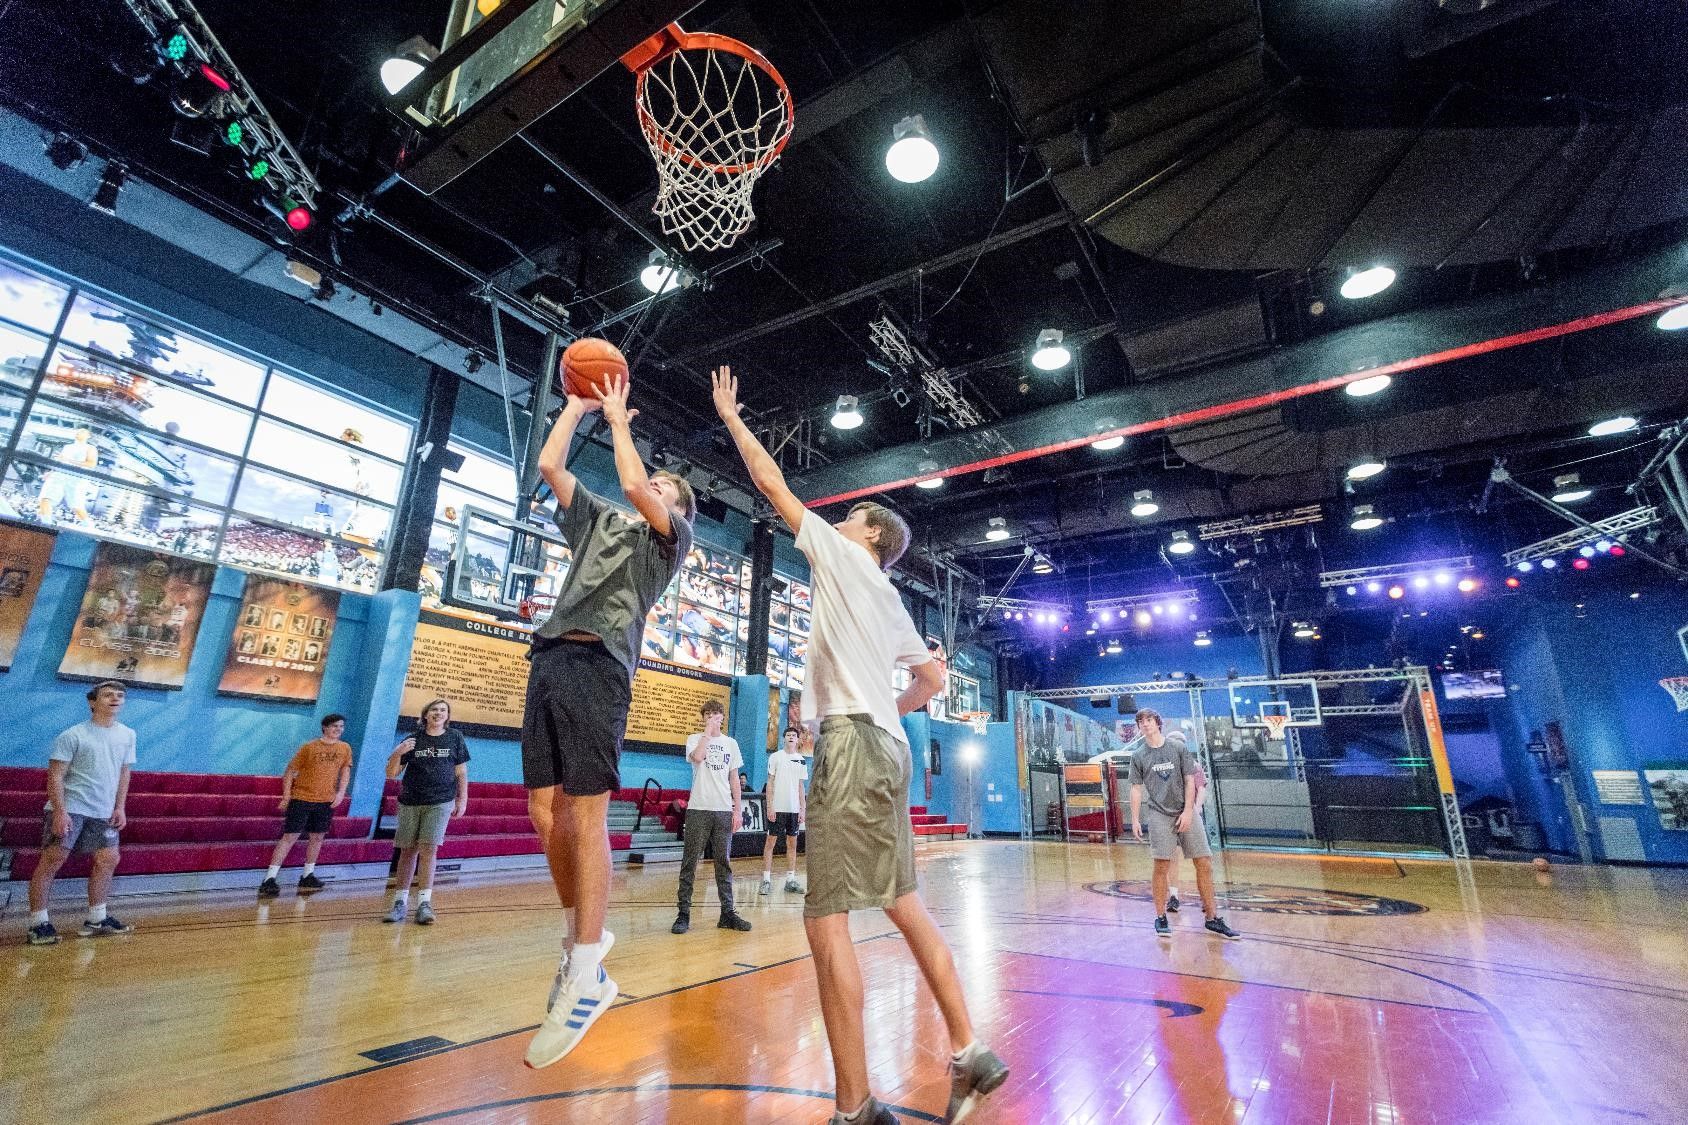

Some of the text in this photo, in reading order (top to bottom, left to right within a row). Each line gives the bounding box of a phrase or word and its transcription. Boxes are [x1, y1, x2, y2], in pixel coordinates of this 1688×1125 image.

[80, 638, 134, 652] CLASS
[144, 646, 181, 658] 2009
[466, 620, 514, 638] COLLEGE
[676, 668, 703, 678] DONORS
[236, 655, 316, 672] CLASS OF 2010
